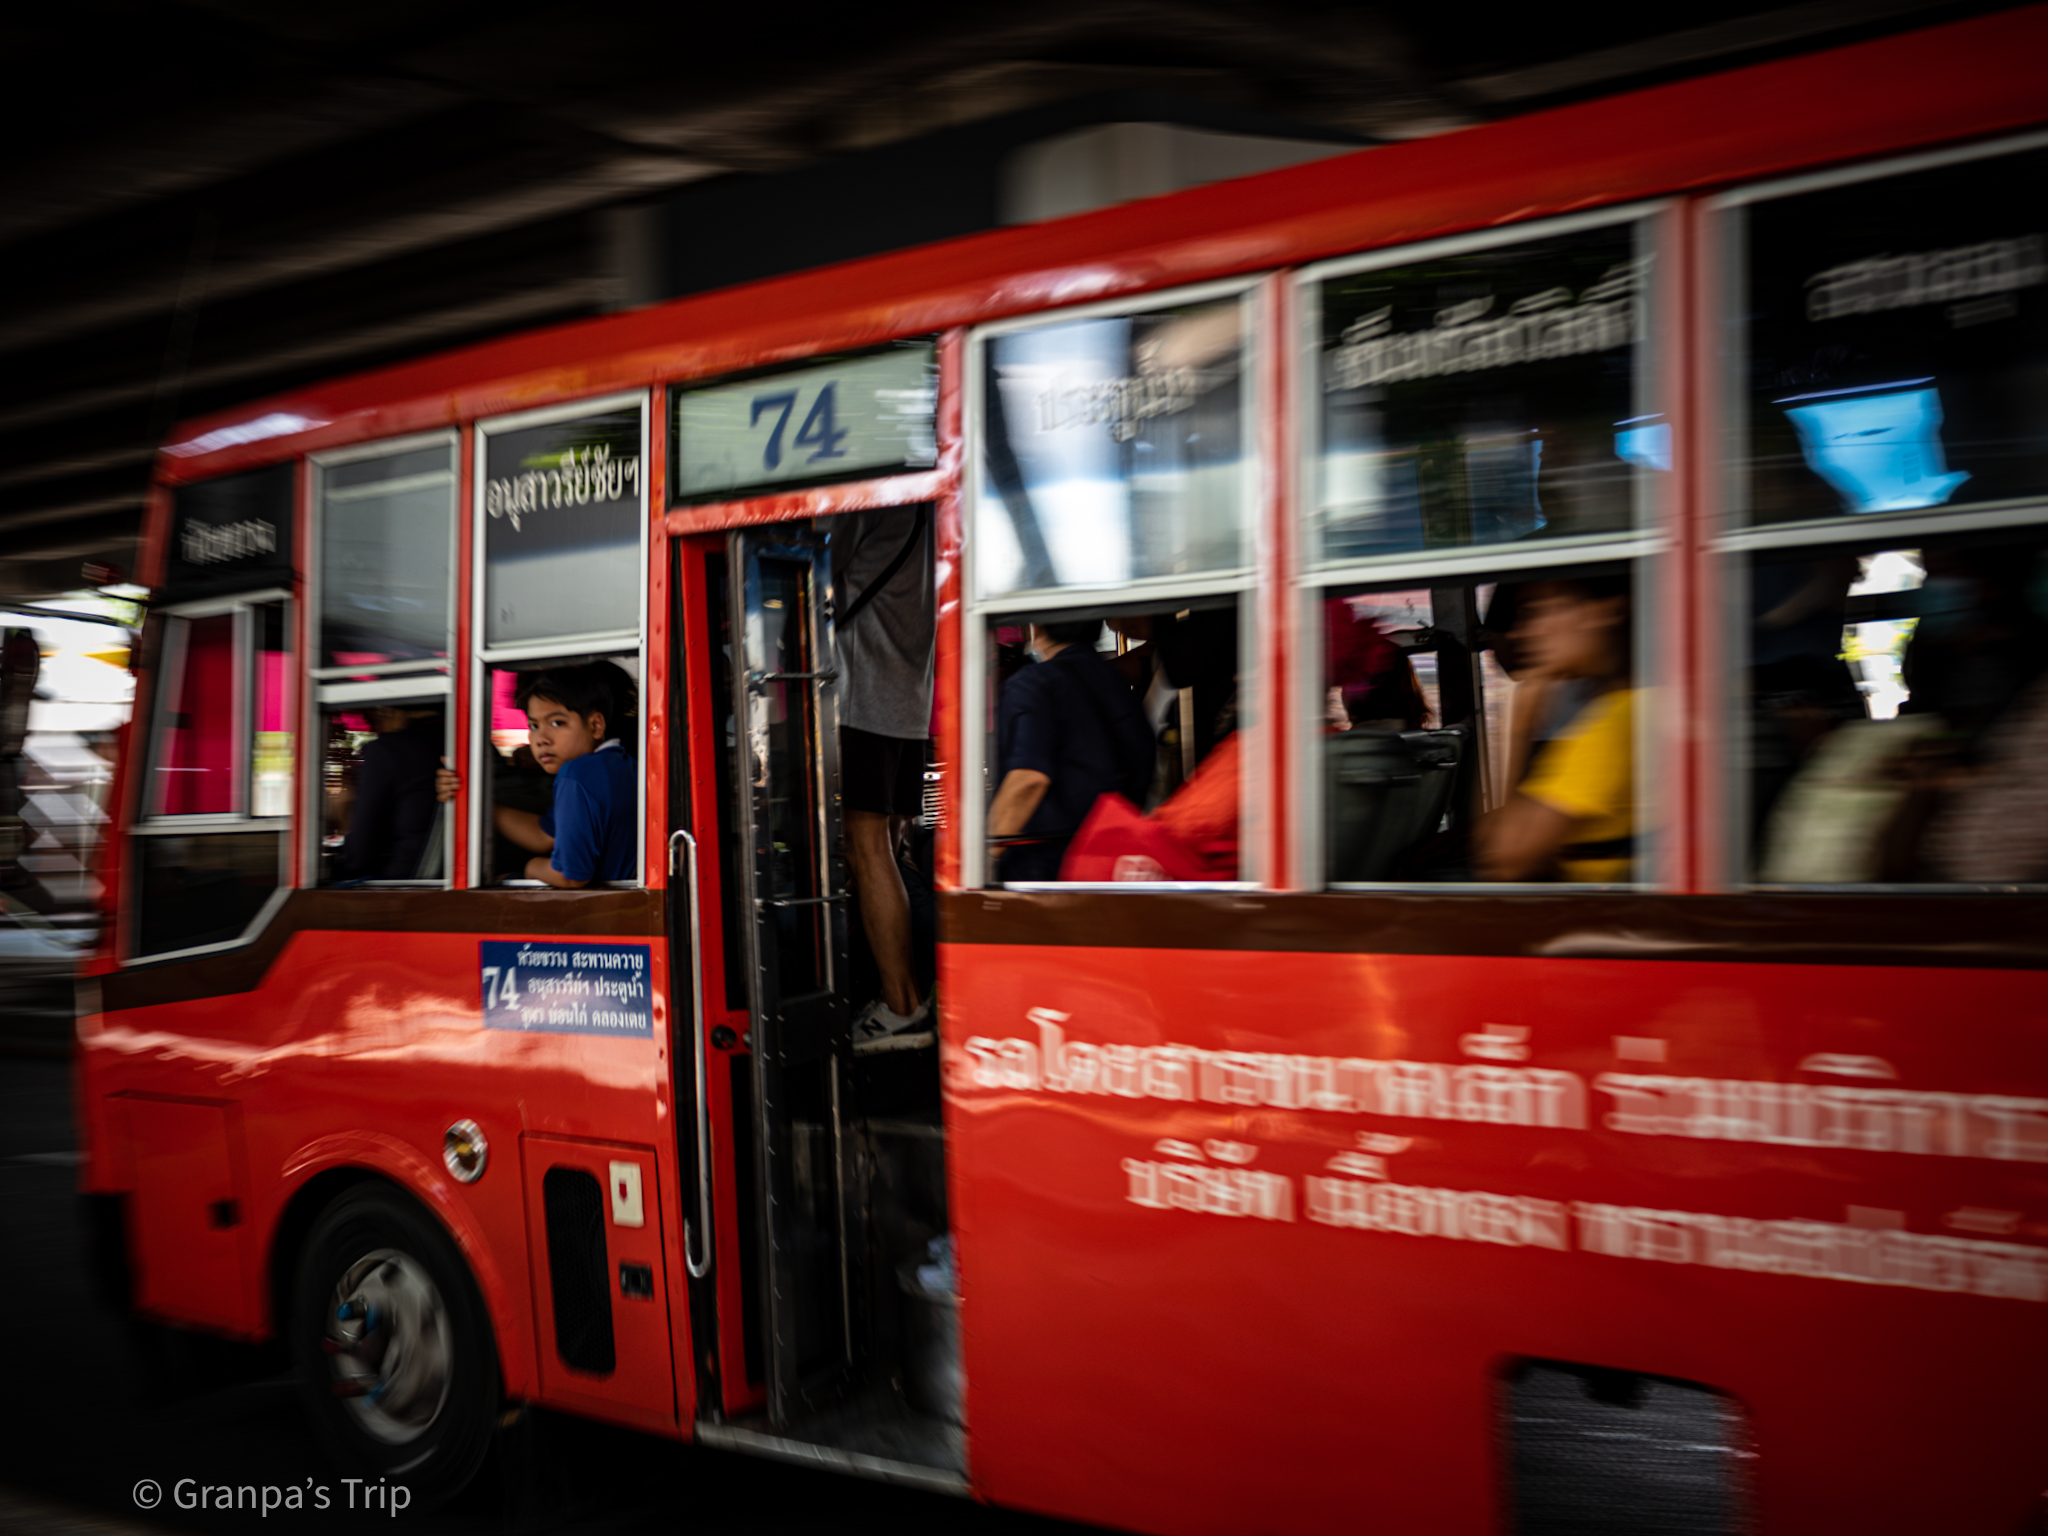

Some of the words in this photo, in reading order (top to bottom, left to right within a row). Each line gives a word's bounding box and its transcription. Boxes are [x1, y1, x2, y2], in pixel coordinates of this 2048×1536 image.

[751, 380, 848, 471] 74
[516, 942, 569, 968] ห้วยขวาง
[571, 950, 644, 970] สะพานควาย
[481, 964, 521, 1011] 74
[594, 971, 644, 1005] ประตูน้ำ
[548, 1000, 588, 1026] บ่อนไก่
[592, 1008, 647, 1030] คลองเตย
